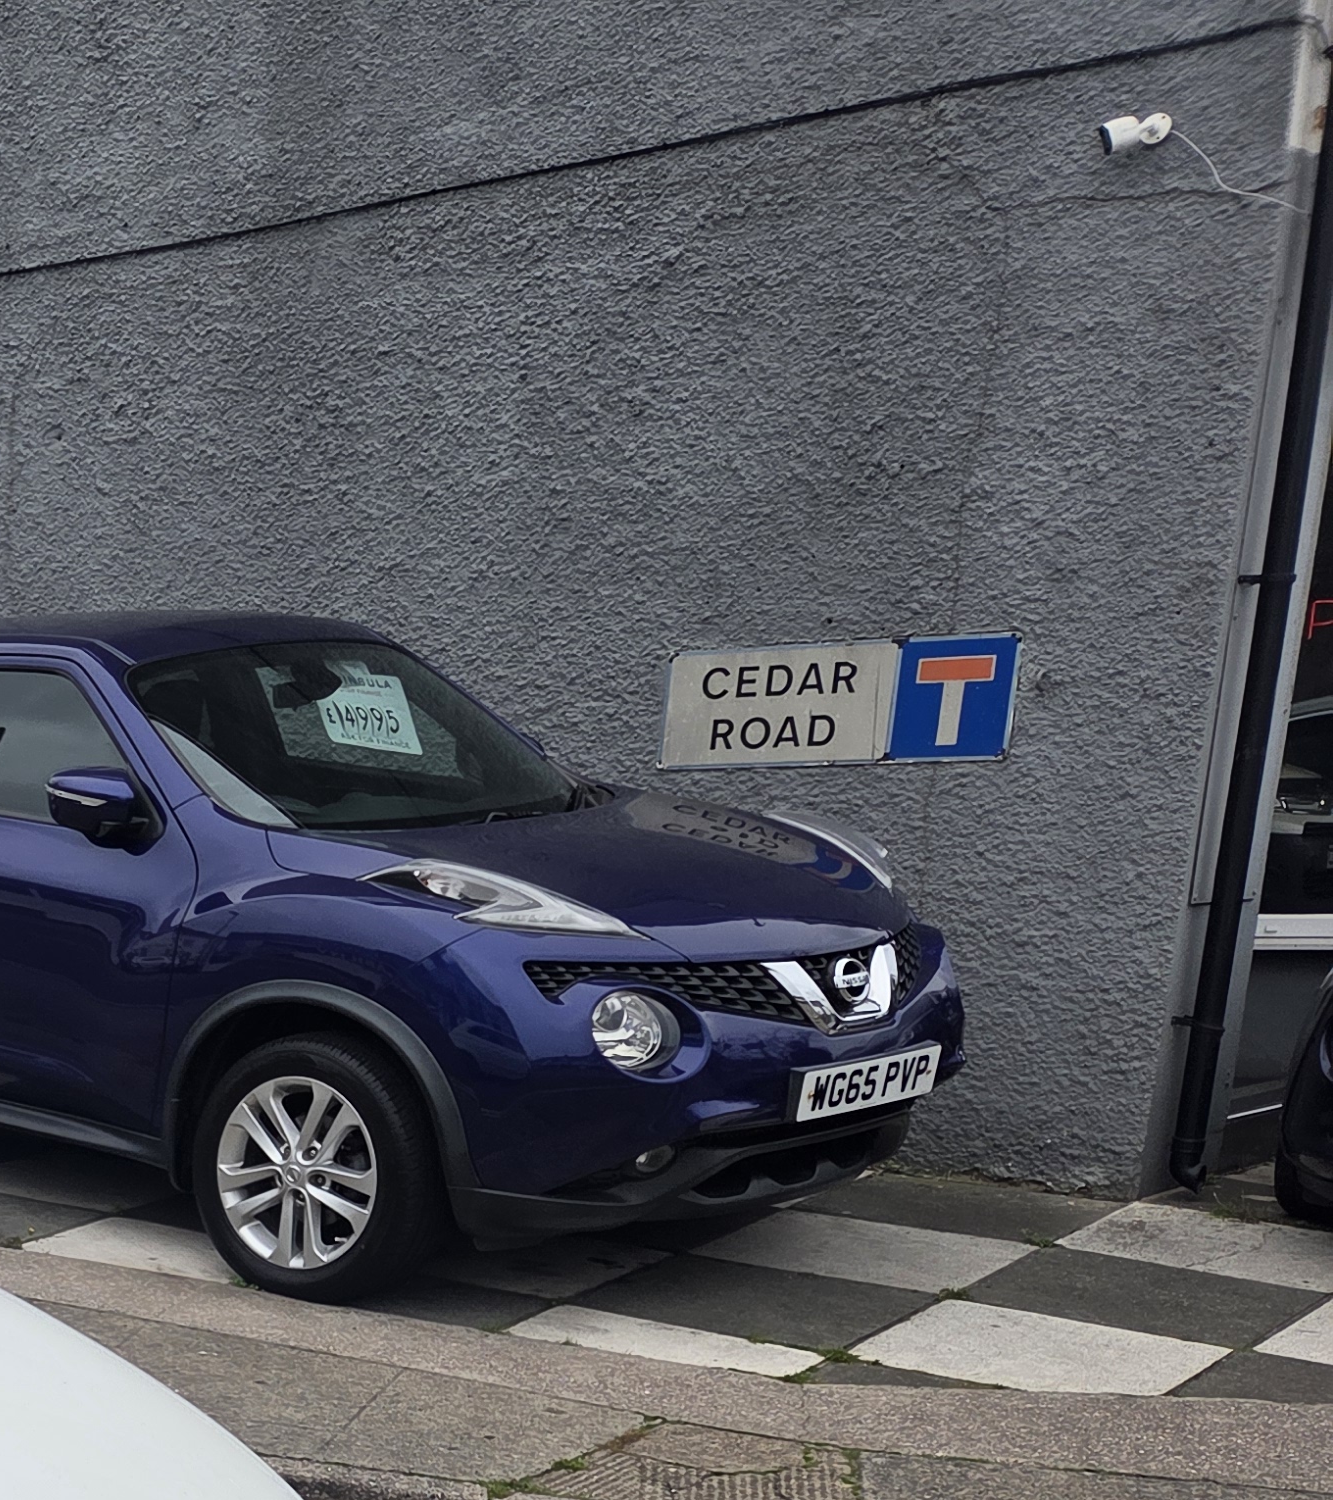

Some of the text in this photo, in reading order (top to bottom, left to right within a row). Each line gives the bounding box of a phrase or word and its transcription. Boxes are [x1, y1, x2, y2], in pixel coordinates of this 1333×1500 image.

[701, 661, 859, 700] CEDAR
[708, 714, 836, 751] ROAD
[810, 1054, 931, 1112] WG65 PVP
